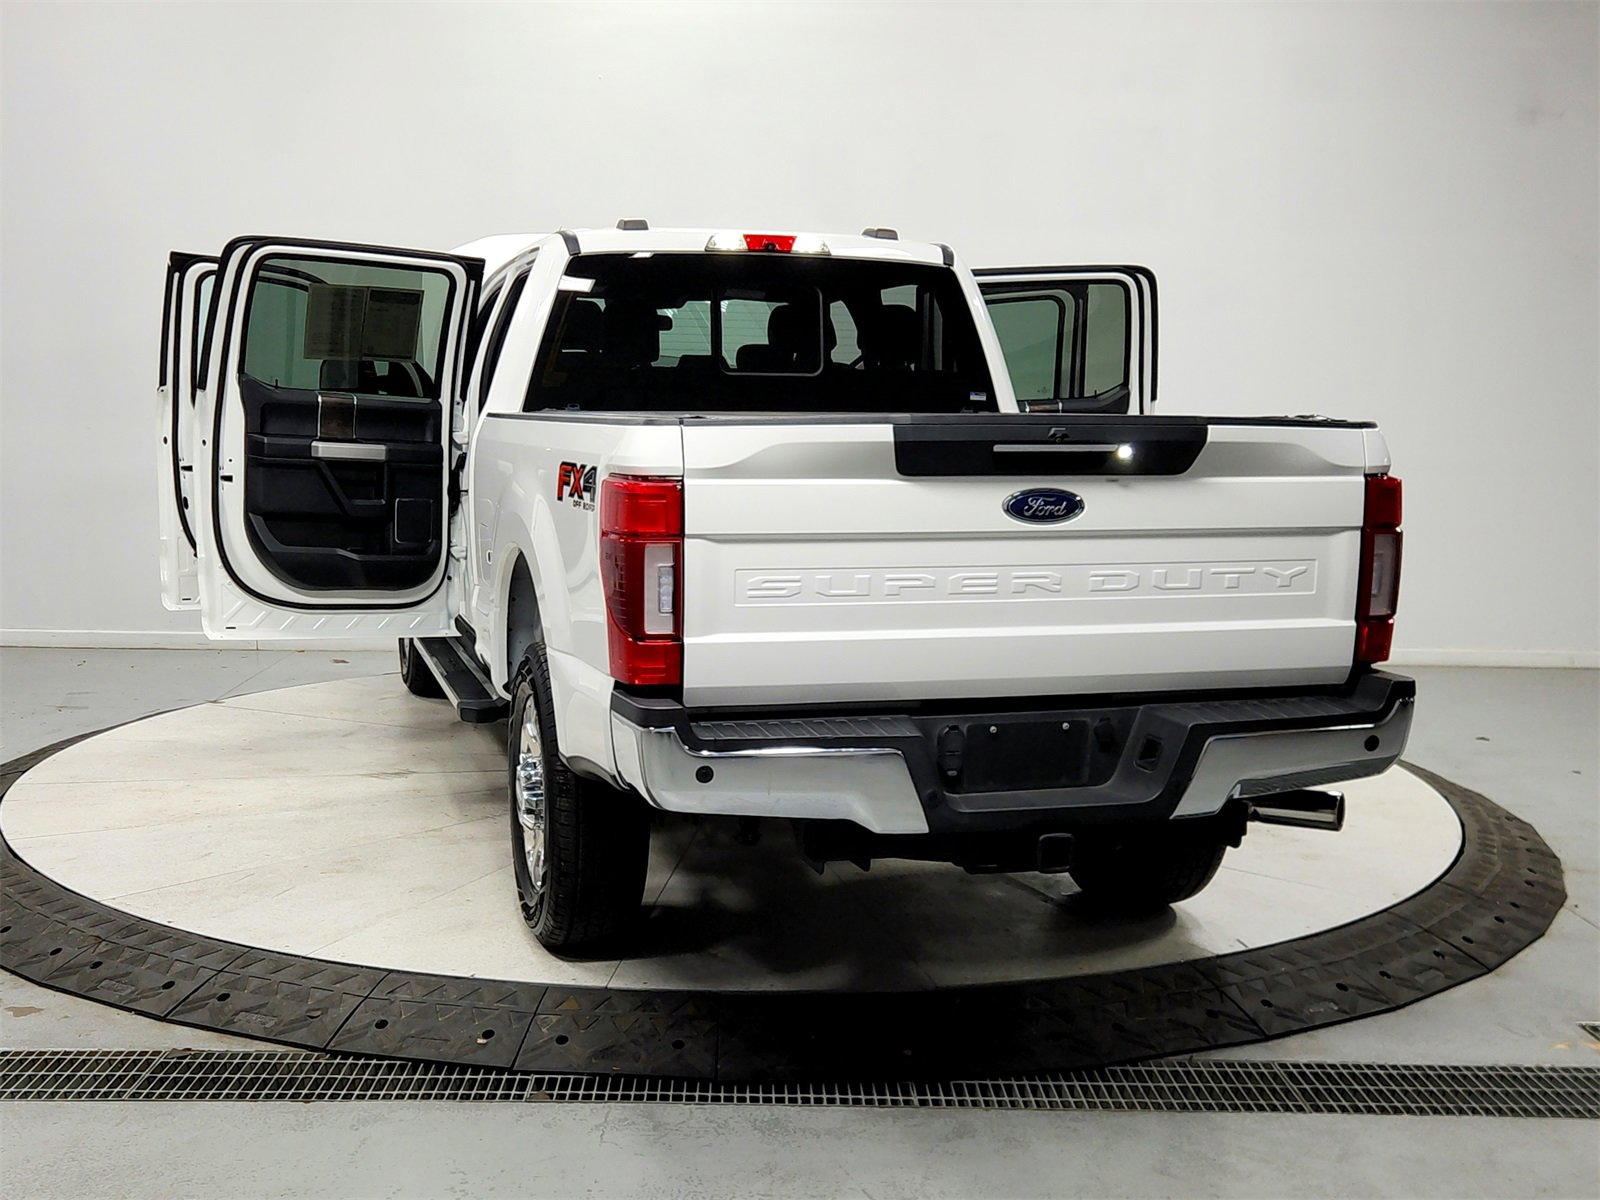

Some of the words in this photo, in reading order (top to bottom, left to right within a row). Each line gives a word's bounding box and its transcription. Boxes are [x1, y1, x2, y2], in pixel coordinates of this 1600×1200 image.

[557, 461, 597, 503] FX4
[1023, 497, 1067, 516] Ford
[746, 571, 1062, 599] SUPER
[1087, 566, 1307, 593] DUTY
